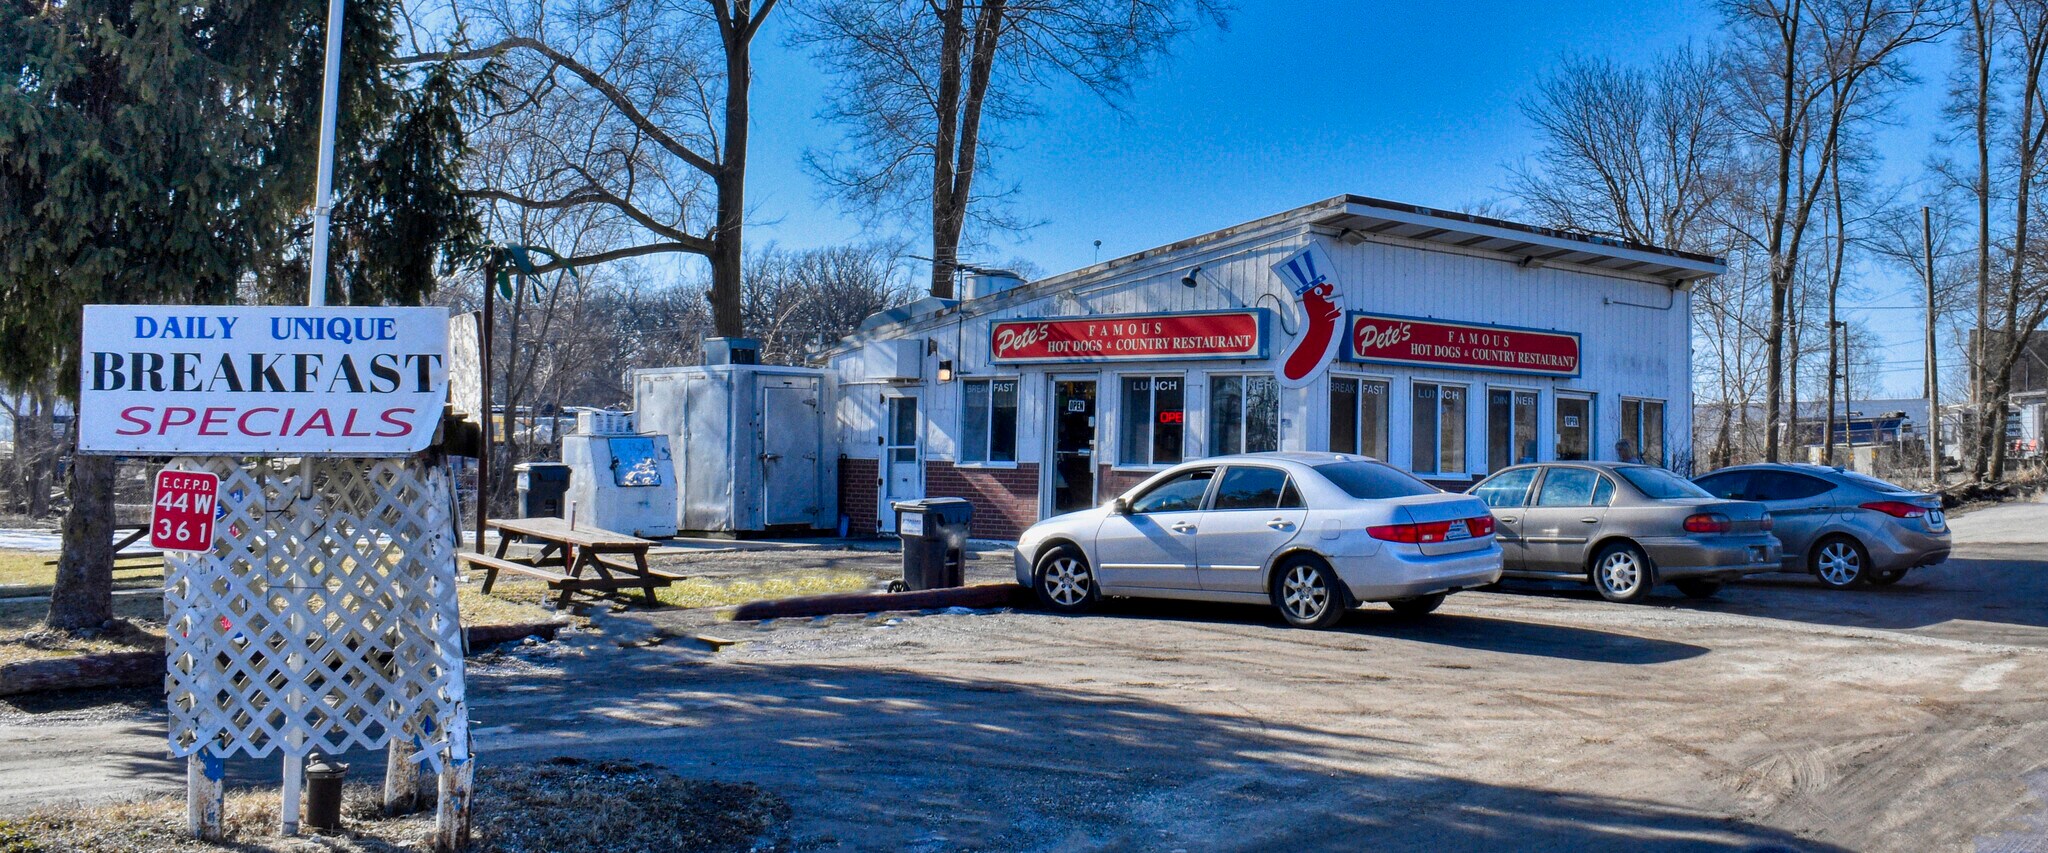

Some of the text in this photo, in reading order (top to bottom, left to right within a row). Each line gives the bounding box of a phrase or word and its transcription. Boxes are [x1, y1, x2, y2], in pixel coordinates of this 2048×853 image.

[133, 316, 398, 345] DAILY UNIQUE
[997, 323, 1049, 358] Pete's
[1088, 322, 1163, 337] FAMOUS
[1359, 322, 1412, 356] Pete's
[1447, 330, 1510, 348] FAMOUS
[1047, 334, 1251, 353] HOT DOGS & COUNTRY RESTAURANT
[1410, 343, 1575, 368] HOT DOGS & COUNTRY RESTAURANT
[89, 351, 442, 394] BREAKFAST
[1069, 400, 1084, 411] OPEN
[1159, 411, 1183, 423] OPE
[115, 406, 416, 437] SPECIALS
[1565, 416, 1578, 426] OPEN
[162, 477, 212, 492] E.C.F.P.D.
[157, 491, 188, 513] 44
[194, 493, 213, 515] W
[157, 518, 207, 543] 361
